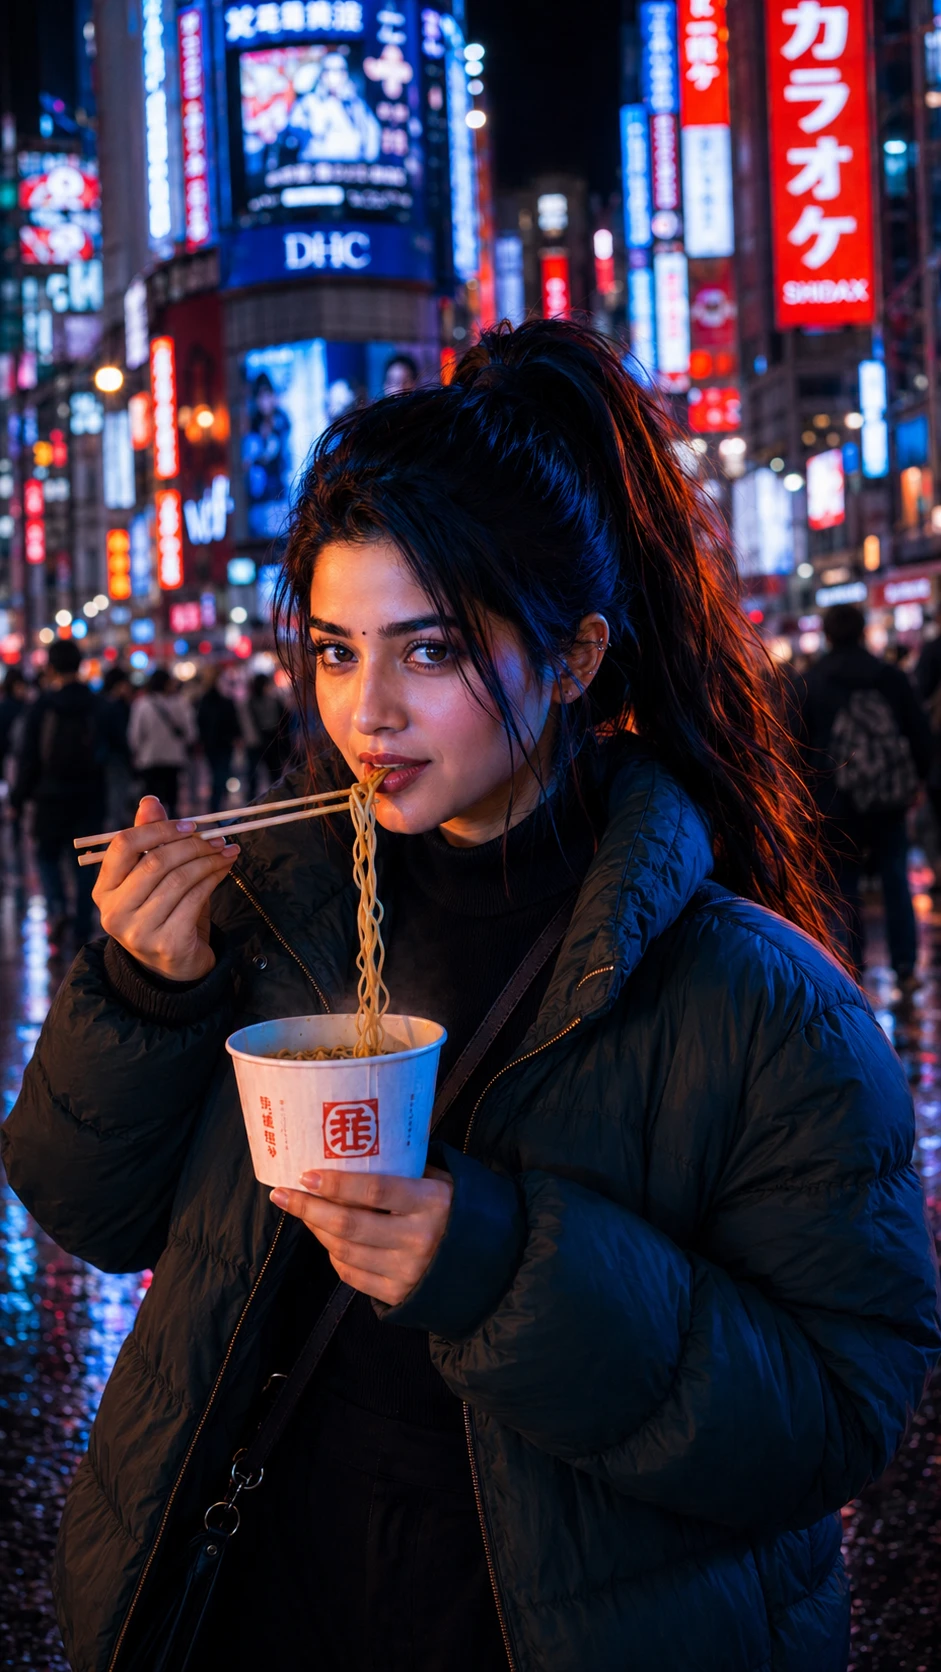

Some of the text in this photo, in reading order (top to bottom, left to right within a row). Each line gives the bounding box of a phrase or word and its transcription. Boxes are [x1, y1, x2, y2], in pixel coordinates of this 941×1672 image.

[780, 1, 857, 270] カラオケ
[284, 231, 371, 269] DHC
[783, 279, 868, 305] SHIDAX
